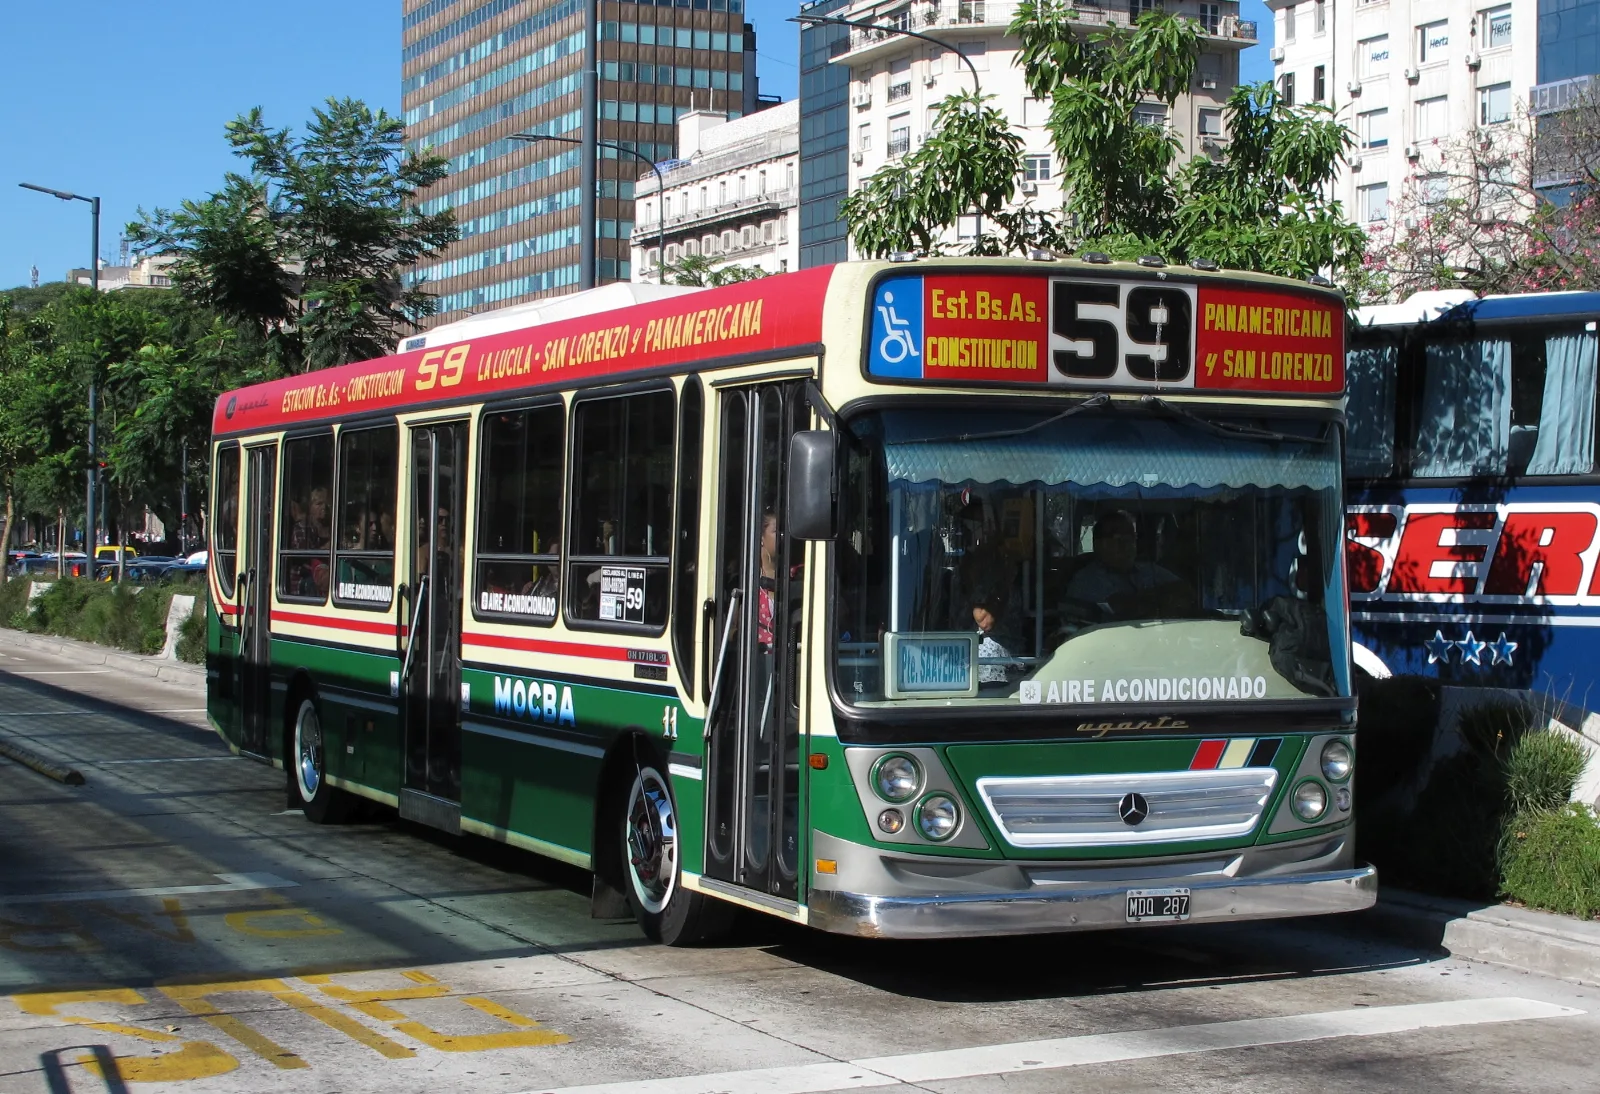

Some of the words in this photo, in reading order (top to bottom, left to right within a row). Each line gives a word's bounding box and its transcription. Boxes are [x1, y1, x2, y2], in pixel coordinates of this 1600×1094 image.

[1371, 50, 1389, 62] Hertz
[1429, 36, 1449, 49] Hertz
[1052, 280, 1192, 382] 59
[1204, 303, 1332, 338] PANAMERICANA
[477, 353, 493, 382] LA
[492, 344, 533, 379] LUCILA
[542, 336, 570, 372] SAN
[569, 324, 631, 366] LORENZO
[643, 298, 764, 354] PANAMERICANA
[926, 336, 1038, 370] CONSTITUCION
[415, 344, 471, 391] 59
[1223, 349, 1256, 379] SAN
[1260, 351, 1333, 382] LORENZO
[281, 385, 316, 413] ESTACION
[347, 368, 406, 402] CONSTITUCION
[345, 583, 356, 598] AIRE
[355, 584, 392, 602] ACONDICIONADO
[489, 592, 503, 611] AIRE
[503, 594, 556, 617] ACONDICIONADO
[626, 587, 643, 610] 59
[920, 645, 966, 684] SAAVEDRA
[494, 675, 576, 728] MOCBA
[1046, 679, 1095, 703] AIRE
[1101, 676, 1267, 702] ACONDICIONADO
[662, 705, 678, 741] 11
[1129, 898, 1154, 916] MDQ
[1163, 897, 1188, 915] 287
